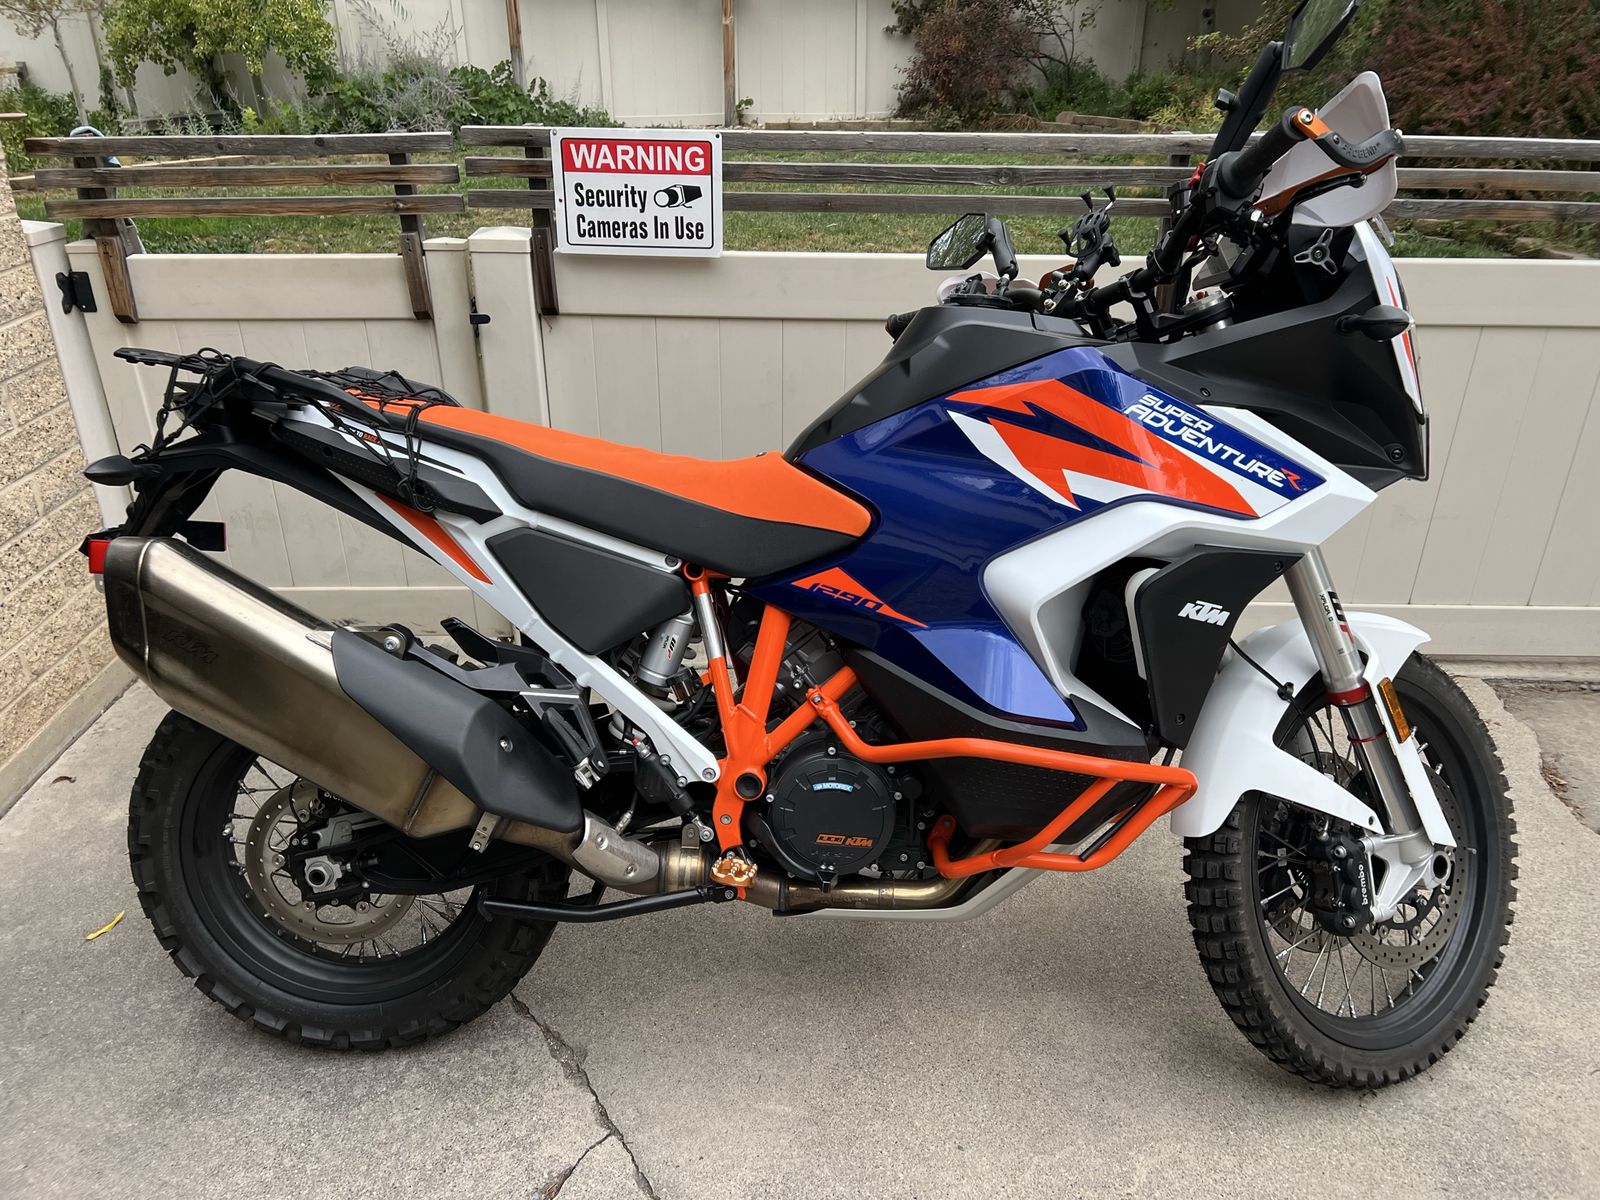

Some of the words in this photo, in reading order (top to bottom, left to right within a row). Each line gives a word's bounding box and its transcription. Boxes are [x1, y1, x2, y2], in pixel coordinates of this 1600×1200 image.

[569, 143, 705, 172] WARNING
[574, 182, 647, 213] Security
[576, 213, 648, 239] Cameras
[654, 216, 669, 239] In
[675, 216, 705, 240] Use
[1138, 393, 1214, 433] SUPER
[1122, 404, 1287, 488] ADVENTURE
[807, 582, 885, 613] 1290
[1177, 600, 1231, 627] KTM
[1357, 863, 1369, 906] brembo
